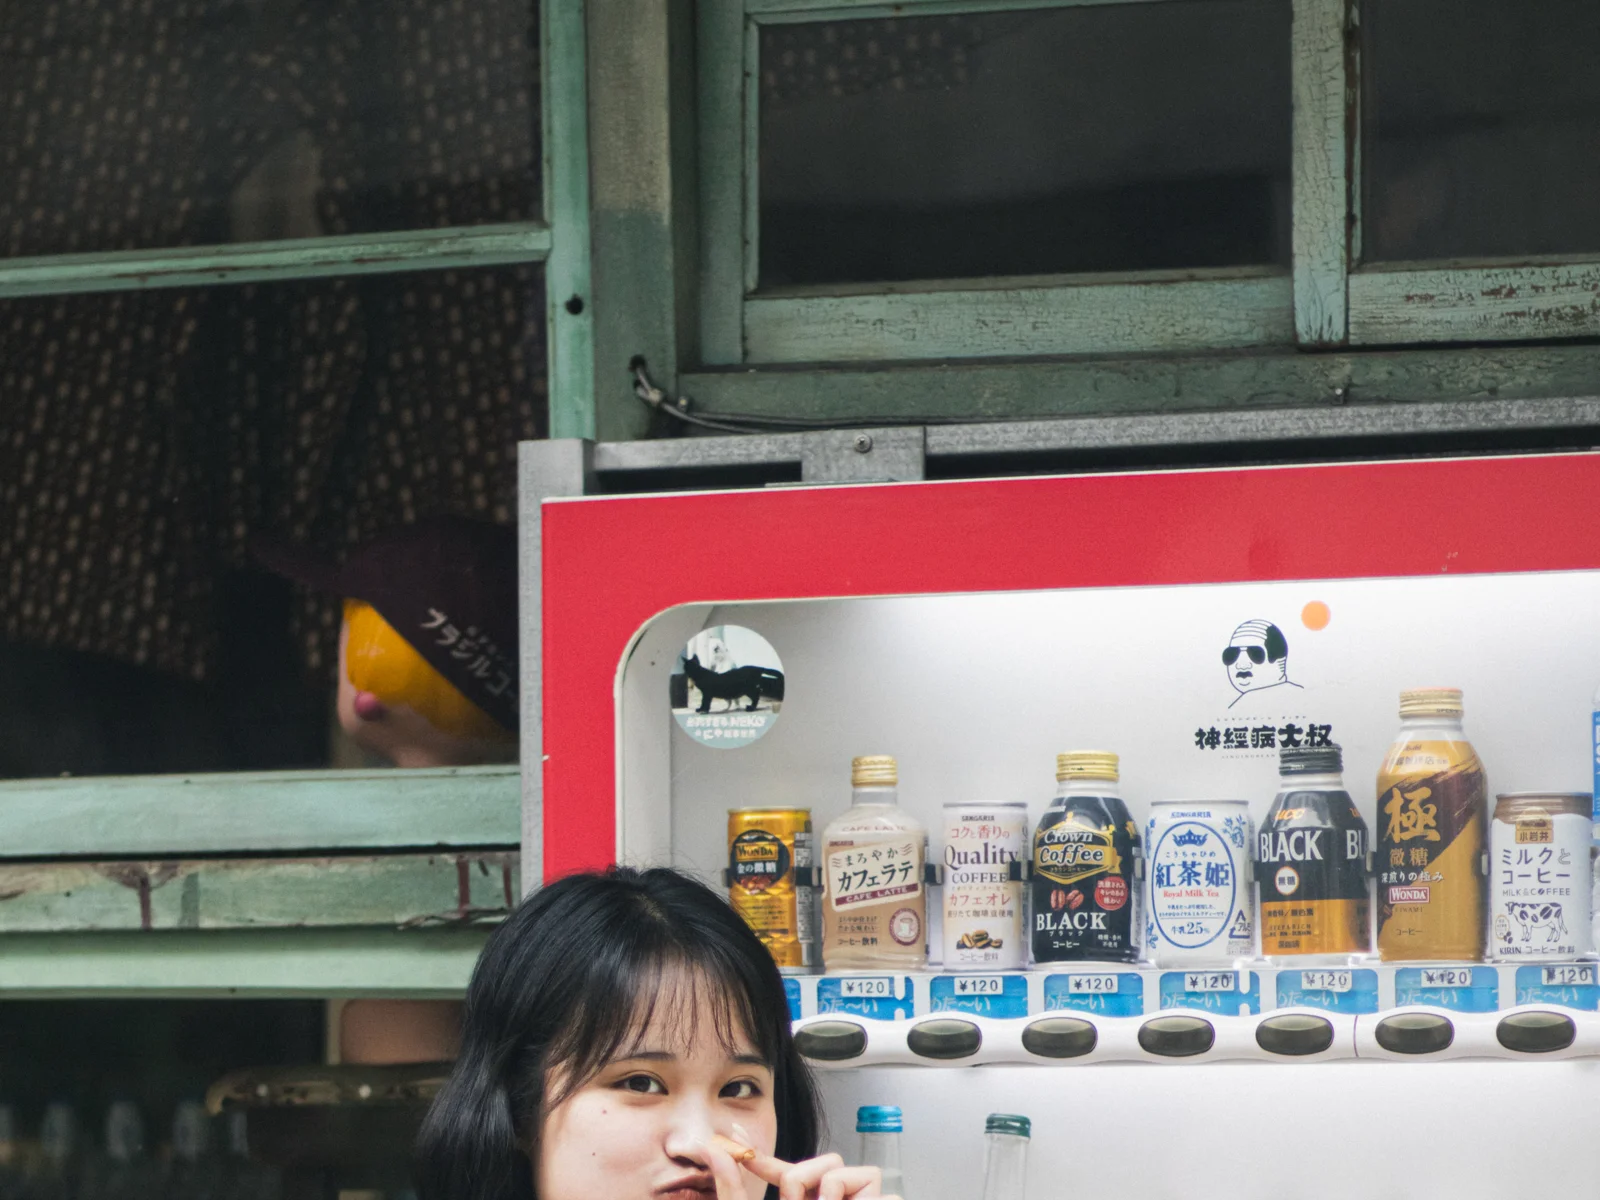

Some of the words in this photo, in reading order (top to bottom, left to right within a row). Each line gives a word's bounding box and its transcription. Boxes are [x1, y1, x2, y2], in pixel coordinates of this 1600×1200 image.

[1195, 723, 1333, 750] 神經病大叔
[1383, 786, 1441, 843] 極
[951, 825, 1010, 839] コクと香りの
[1045, 830, 1093, 844] Crown
[1519, 831, 1549, 842] 小岩井
[738, 846, 773, 857] WONDA
[1261, 830, 1323, 862] BLACK
[845, 847, 898, 866] まろやか
[944, 842, 1018, 870] Quality
[1040, 843, 1103, 866] Coffee
[1390, 848, 1428, 866] 微糖
[1502, 847, 1571, 865] ミルクと
[838, 861, 913, 893] カフェラテ
[952, 872, 1008, 884] COFFEE
[1156, 861, 1230, 888] 紅茶姫
[1381, 869, 1444, 882] 深煎りの極み
[1502, 868, 1571, 885] コーヒー
[846, 891, 873, 902] CAFE
[877, 886, 908, 898] LATTE
[949, 893, 1011, 907] カフェオレ
[1163, 890, 1183, 898] Royal
[1391, 888, 1427, 900] WONDA
[1036, 912, 1107, 931] BLACK
[1053, 941, 1080, 949] コーヒー
[1500, 946, 1521, 954] KIRIN
[1525, 945, 1575, 954] コーヒー飲料
[846, 981, 885, 994] ¥120
[959, 979, 998, 992] ¥120
[1074, 977, 1113, 989] ¥120
